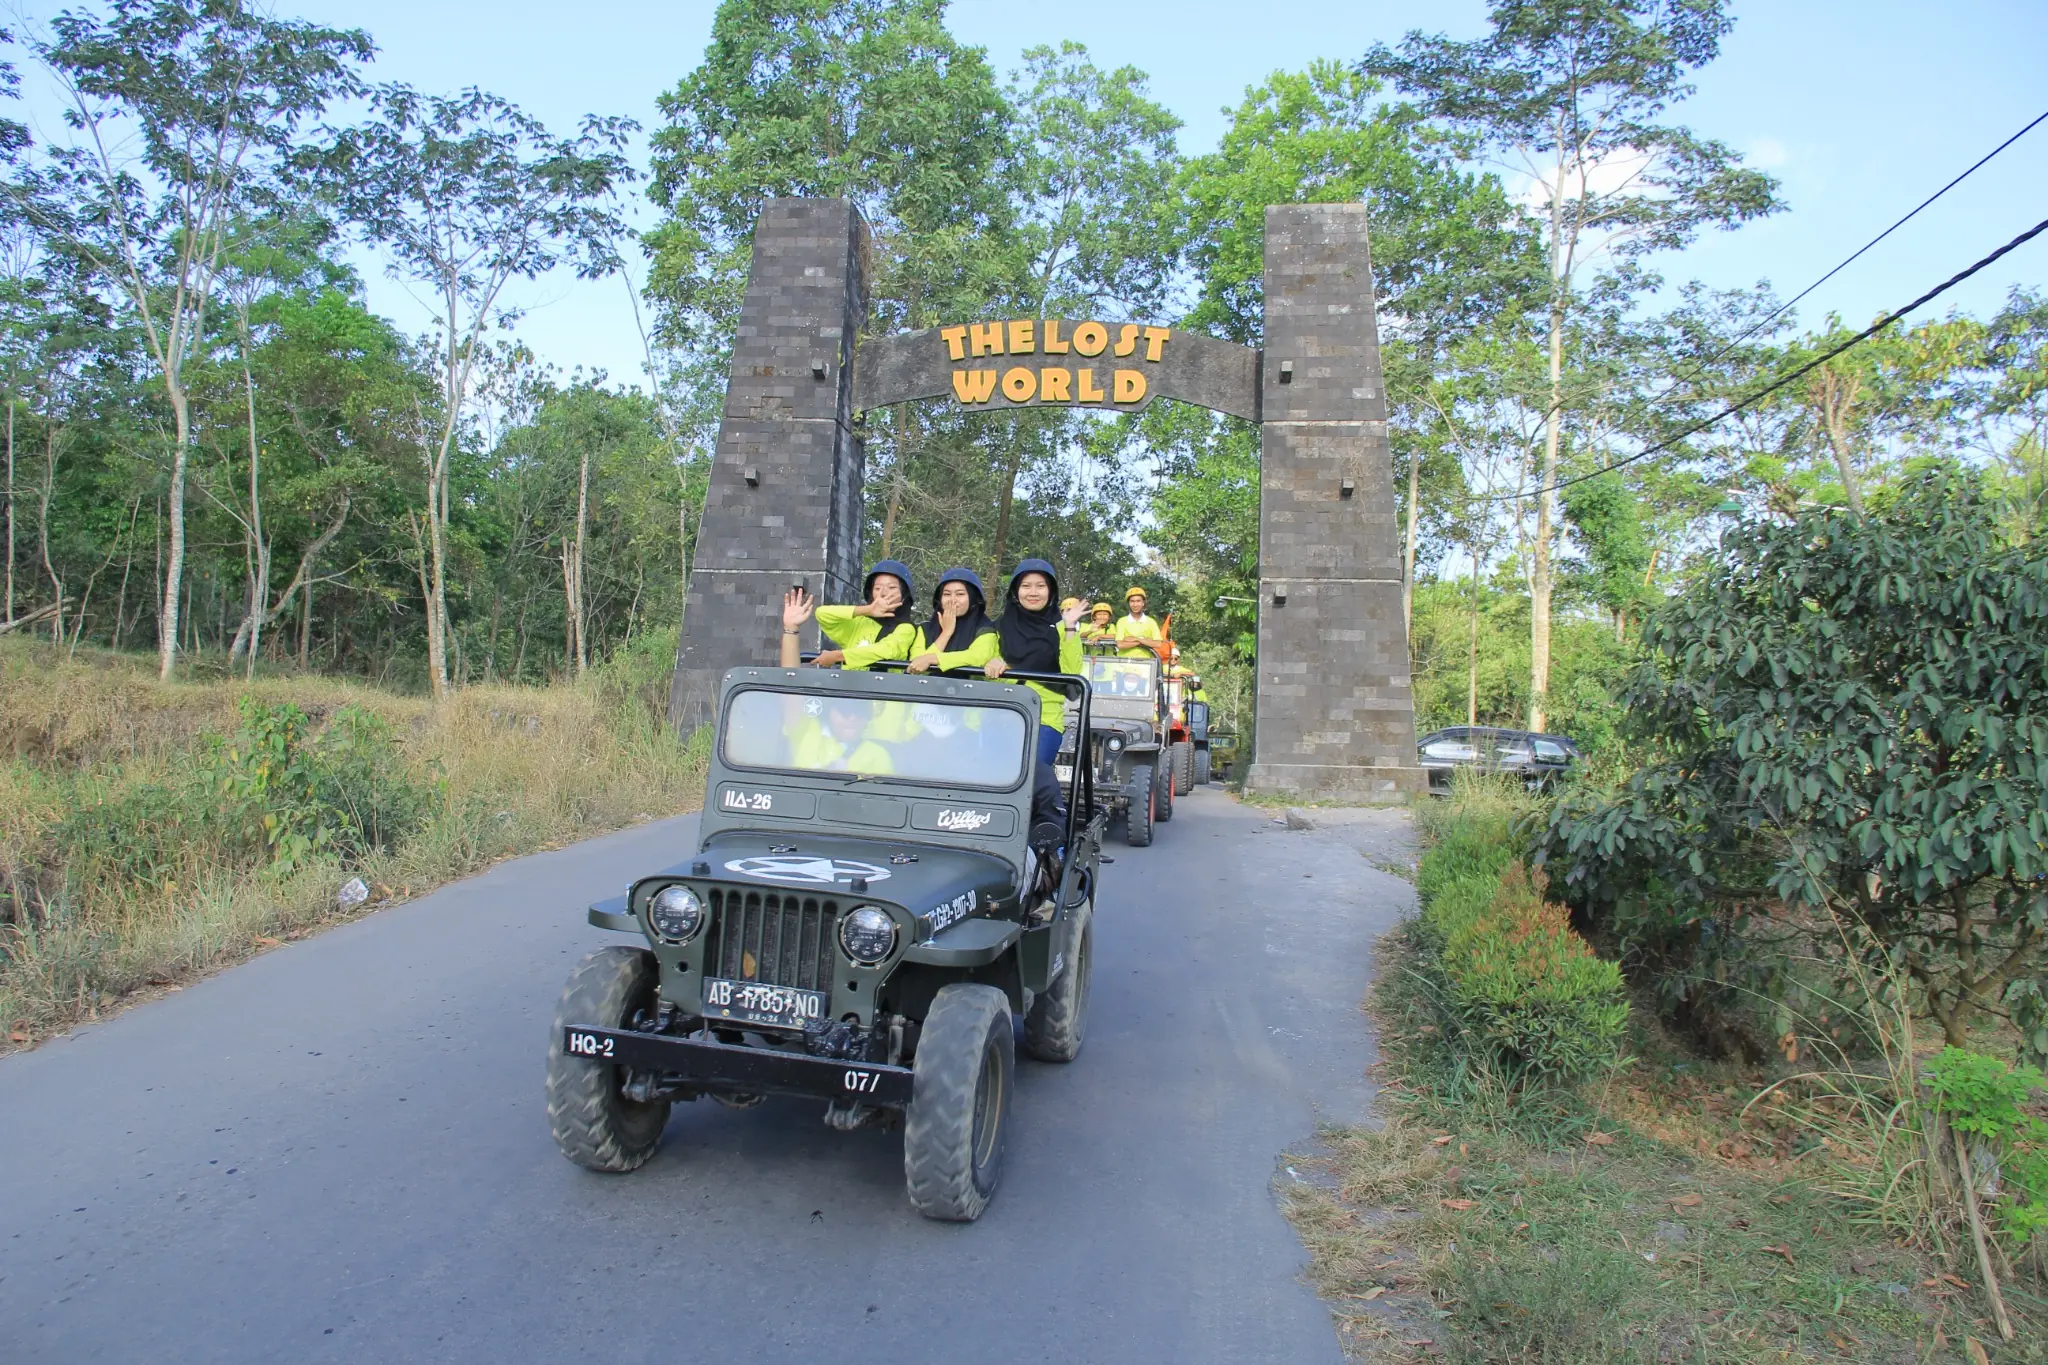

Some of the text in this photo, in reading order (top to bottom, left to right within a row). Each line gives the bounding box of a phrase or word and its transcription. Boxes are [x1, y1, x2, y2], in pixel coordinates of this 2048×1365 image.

[941, 320, 1170, 361] THE LOST
[952, 367, 1147, 403] WORLD
[937, 809, 991, 827] Willys
[708, 981, 731, 1006] AB
[795, 993, 819, 1018] NQ
[570, 1032, 614, 1057] HQ-2
